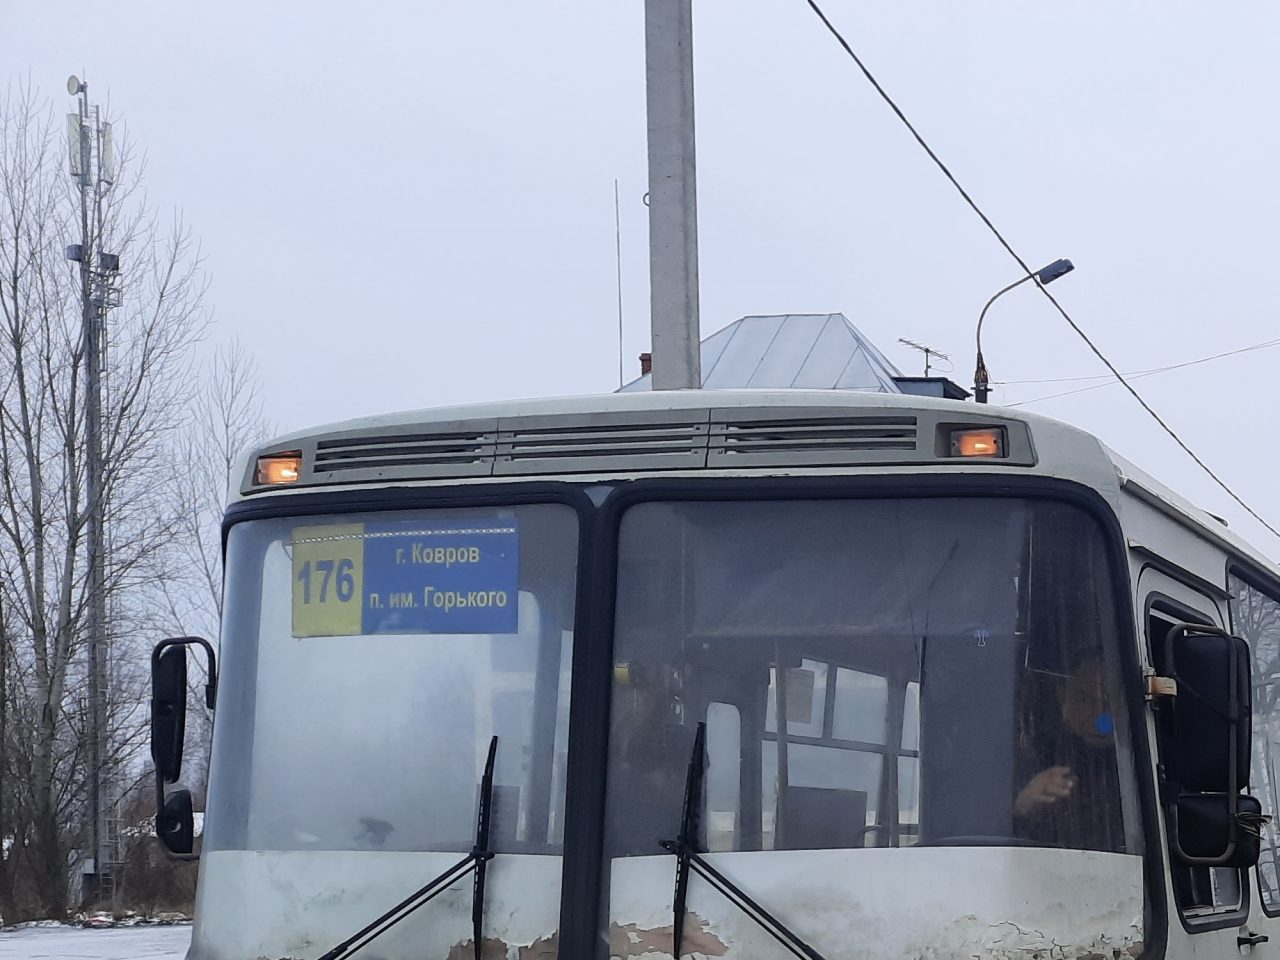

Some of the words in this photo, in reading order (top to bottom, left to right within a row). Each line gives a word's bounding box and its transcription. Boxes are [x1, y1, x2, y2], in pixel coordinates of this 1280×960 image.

[396, 548, 406, 564] г.
[412, 542, 480, 568] Ковров
[298, 558, 355, 605] 176
[369, 593, 384, 609] п.
[389, 592, 418, 608] им.
[424, 586, 507, 613] Горького
